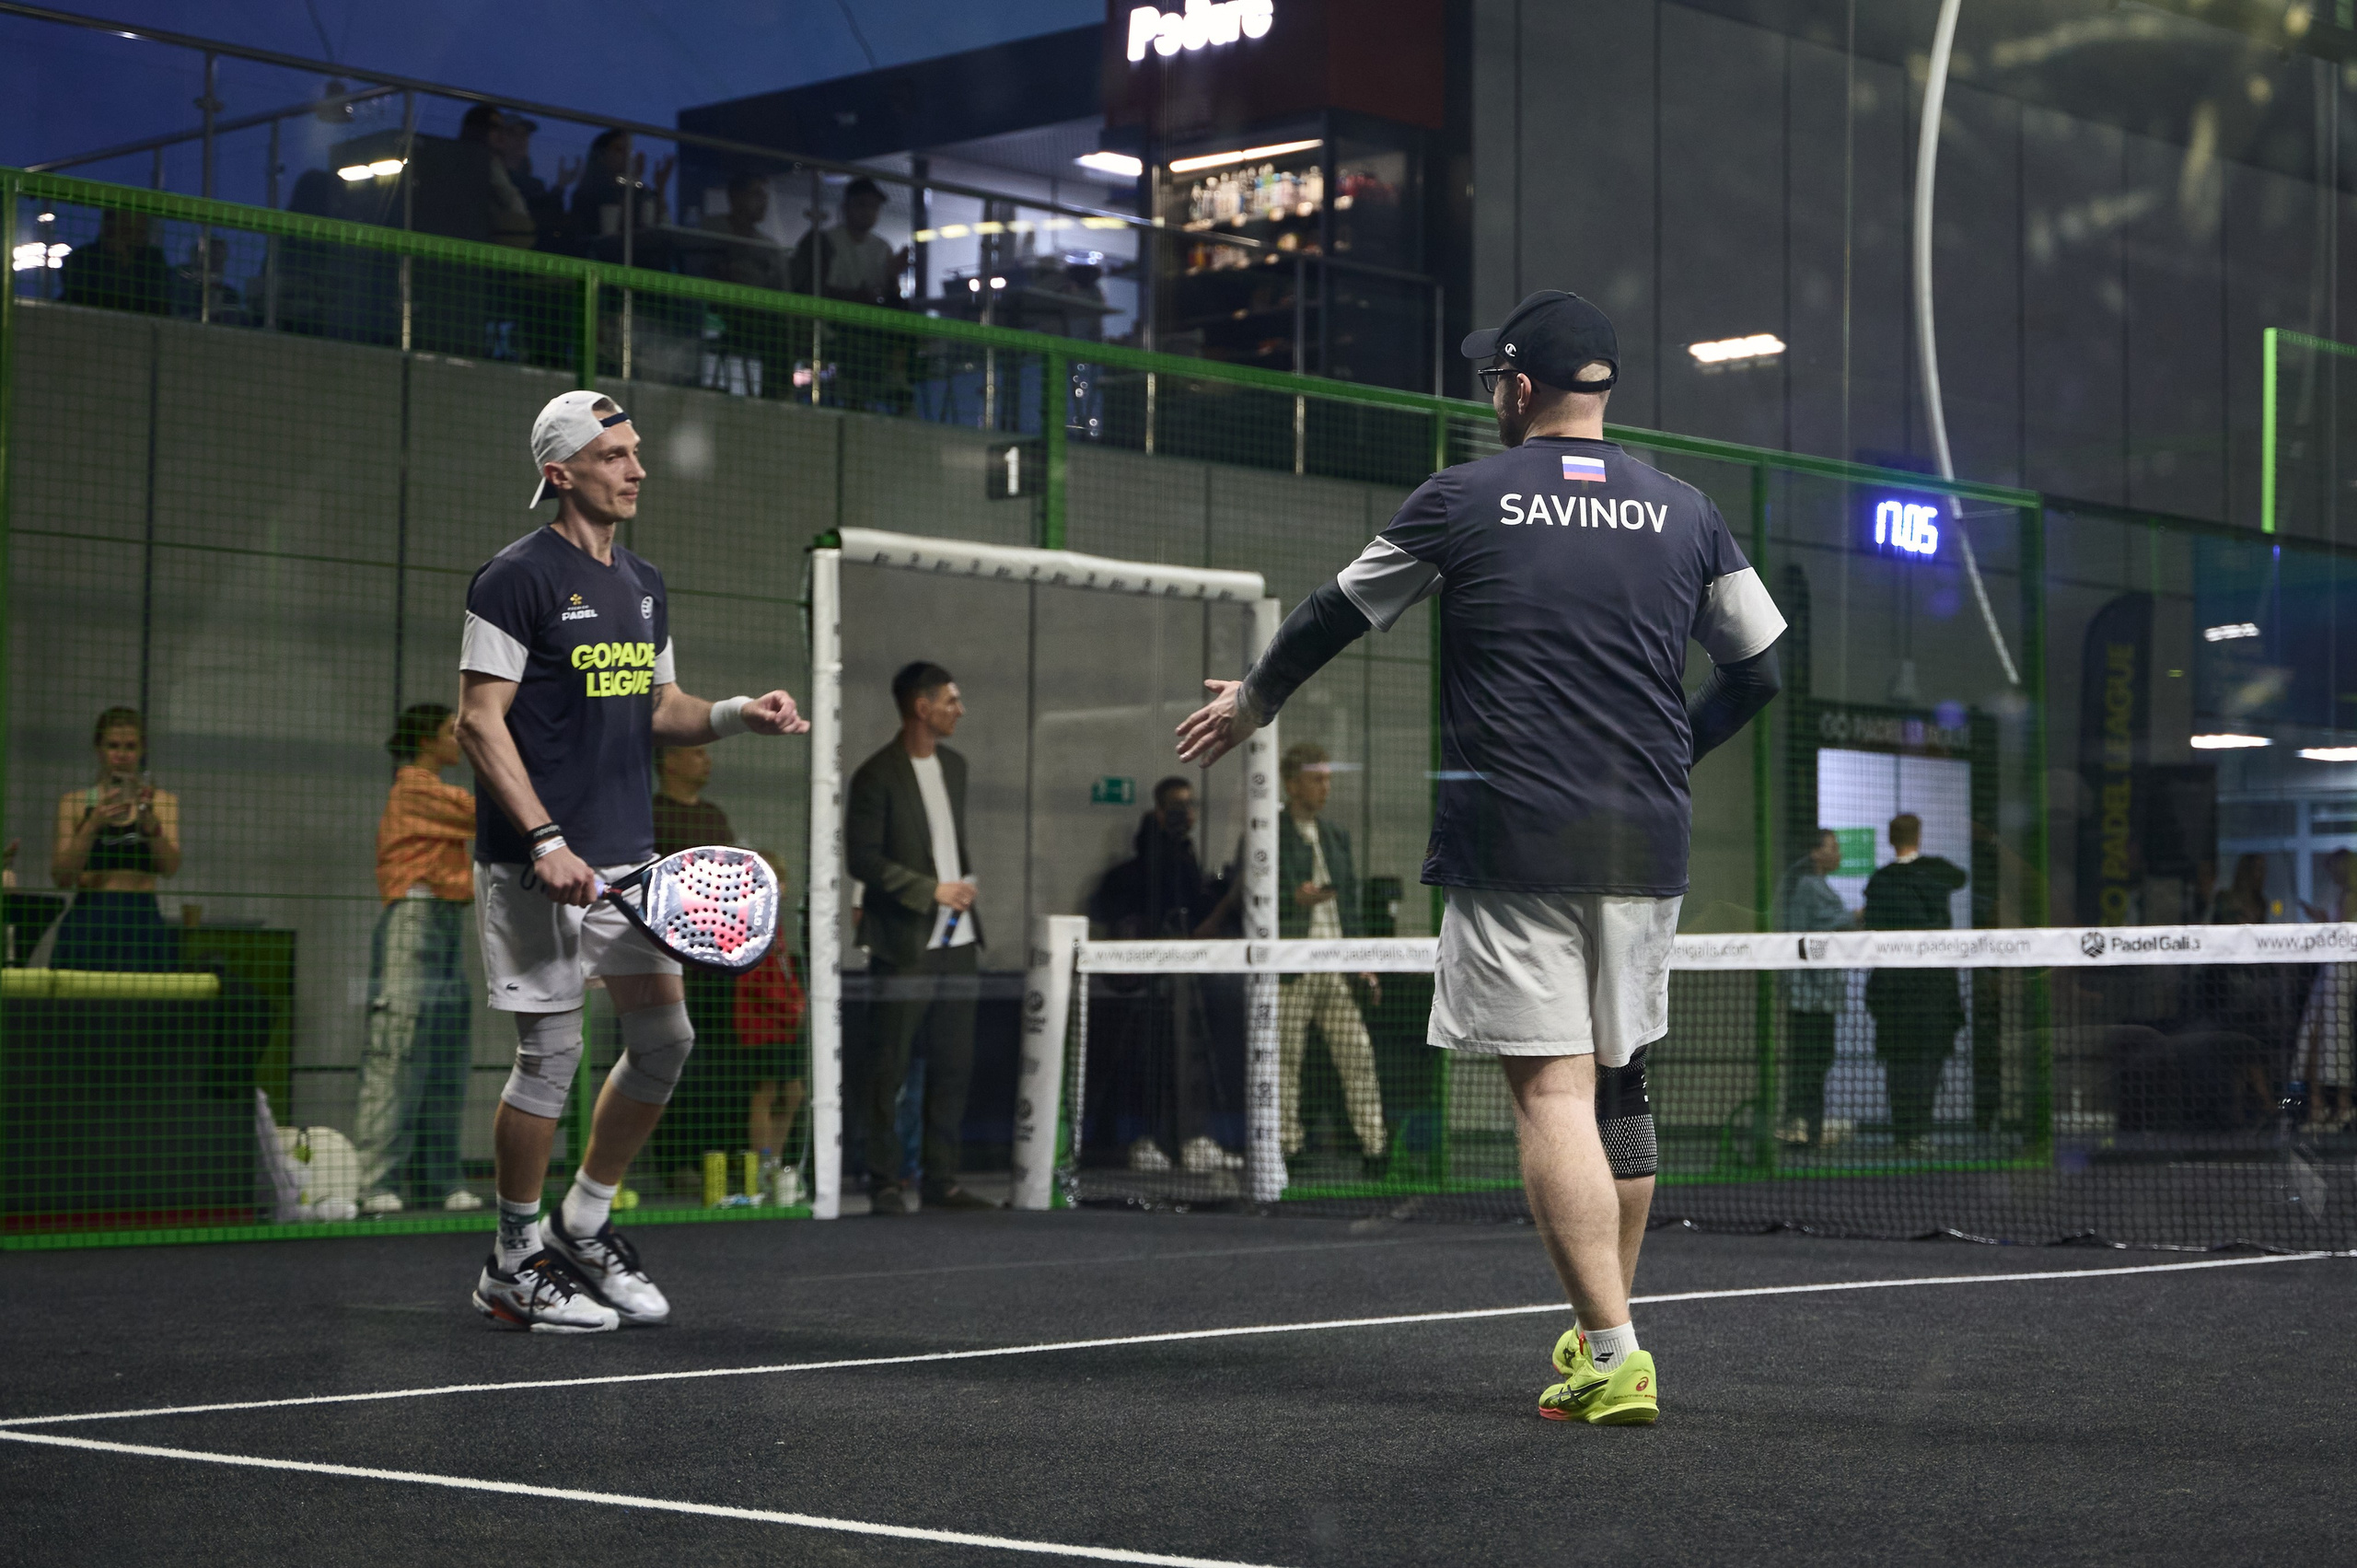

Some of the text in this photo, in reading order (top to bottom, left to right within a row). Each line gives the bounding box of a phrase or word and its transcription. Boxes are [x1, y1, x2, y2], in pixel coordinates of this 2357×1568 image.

[1004, 447, 1019, 496] 1
[1500, 493, 1668, 533] SAVINOV
[562, 609, 598, 621] PADEL
[2105, 643, 2136, 772] LEAGUE
[2101, 778, 2133, 880] PADEL
[1875, 935, 2031, 958] www.padelgalis.com
